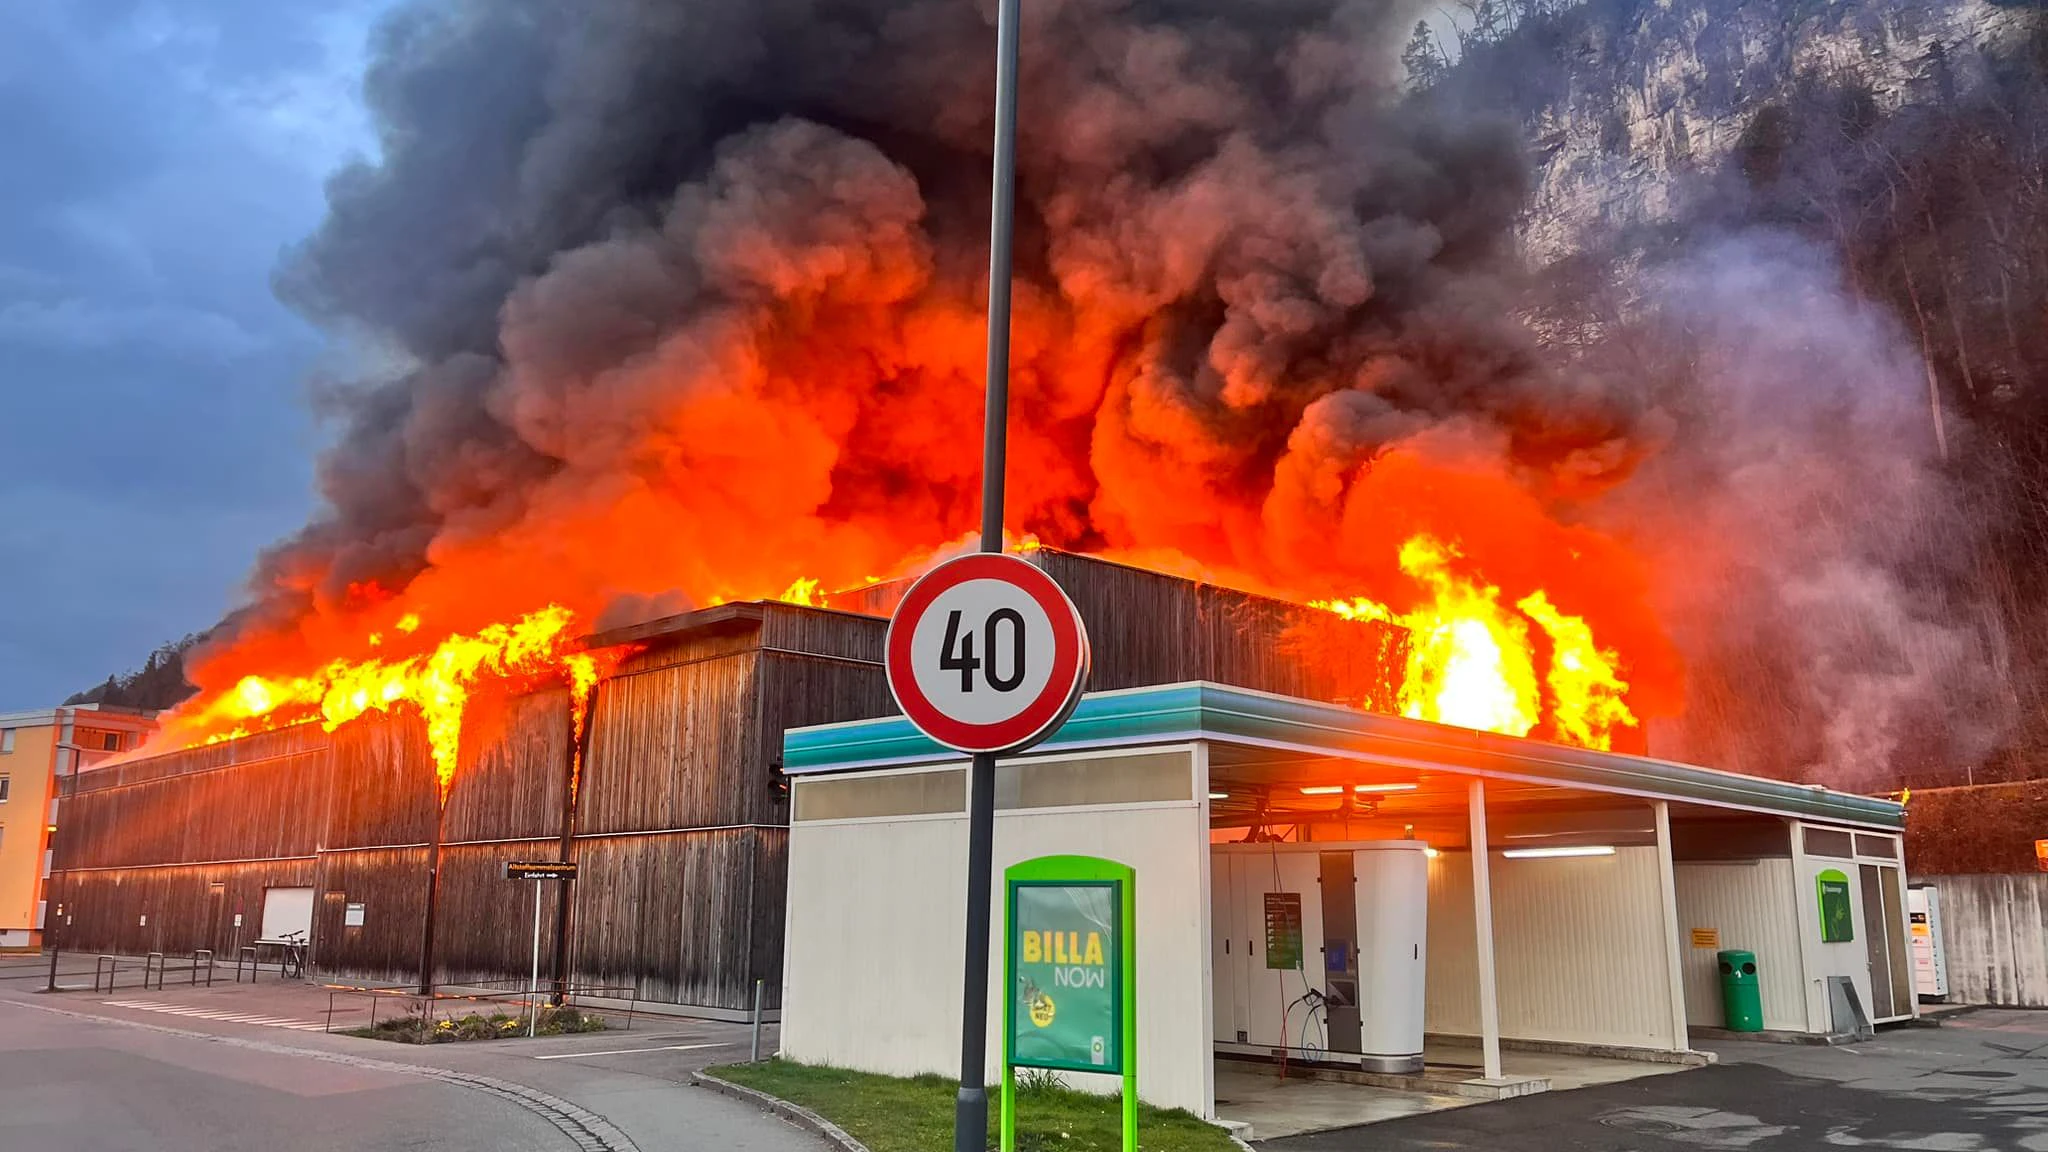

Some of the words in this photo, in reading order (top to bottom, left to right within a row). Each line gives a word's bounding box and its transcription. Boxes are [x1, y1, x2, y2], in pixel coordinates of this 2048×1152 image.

[940, 607, 1026, 693] 40
[1023, 930, 1104, 965] BILLA
[1055, 966, 1105, 988] NOW
